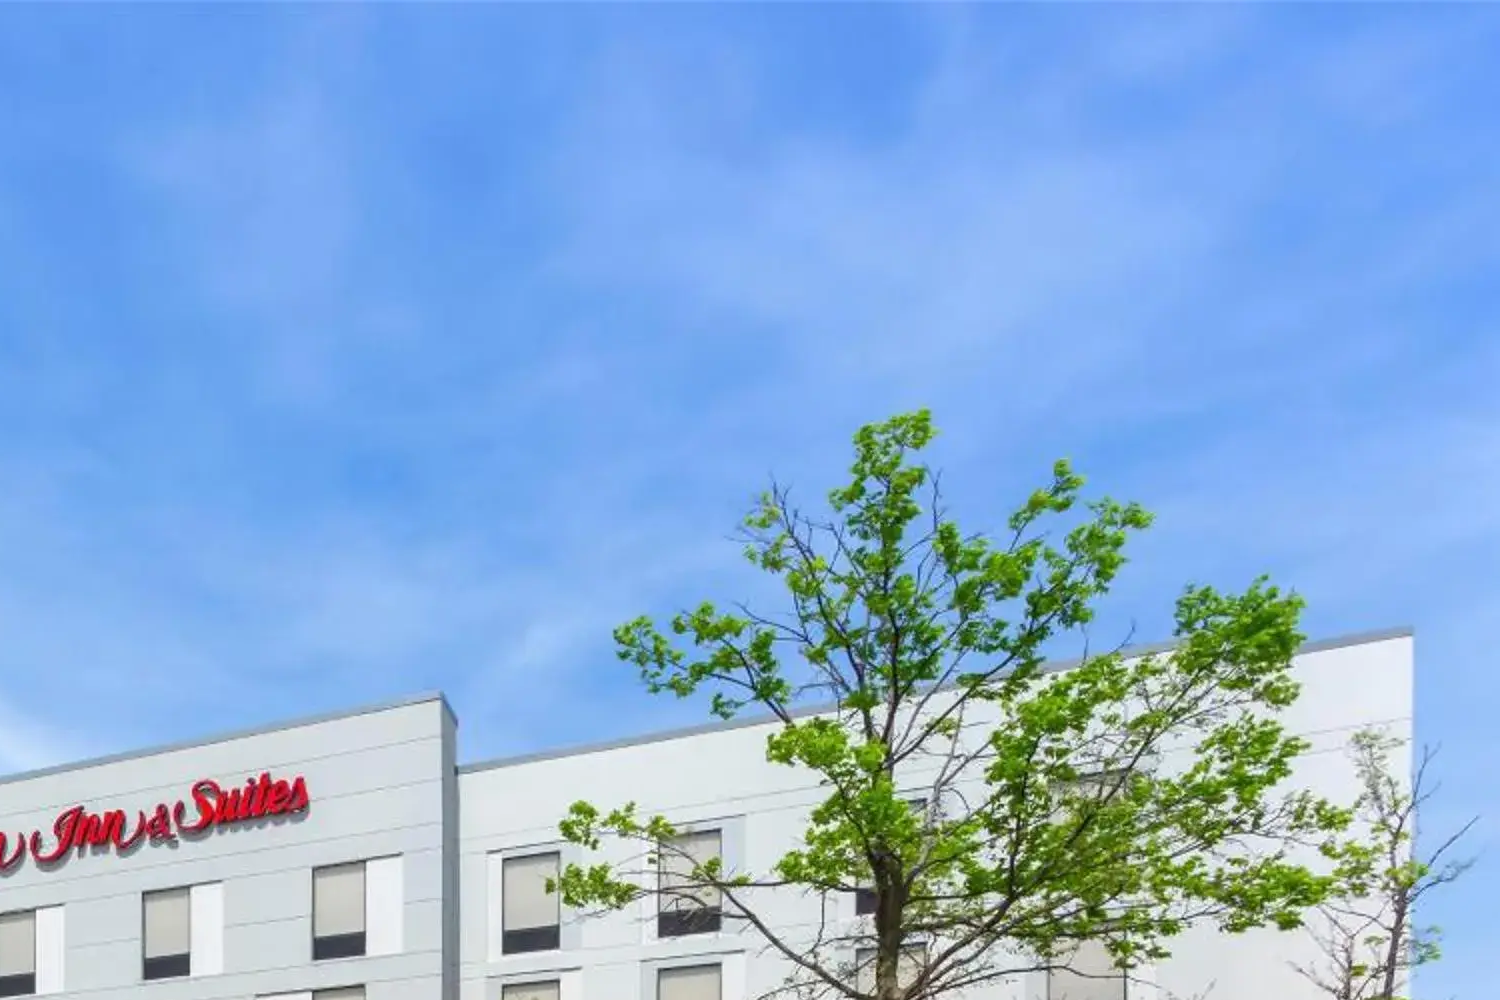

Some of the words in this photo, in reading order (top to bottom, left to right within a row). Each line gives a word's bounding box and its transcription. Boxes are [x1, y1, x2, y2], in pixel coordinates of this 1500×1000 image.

[31, 805, 146, 862] Inn
[146, 803, 173, 839] &
[174, 772, 310, 833] Suites
